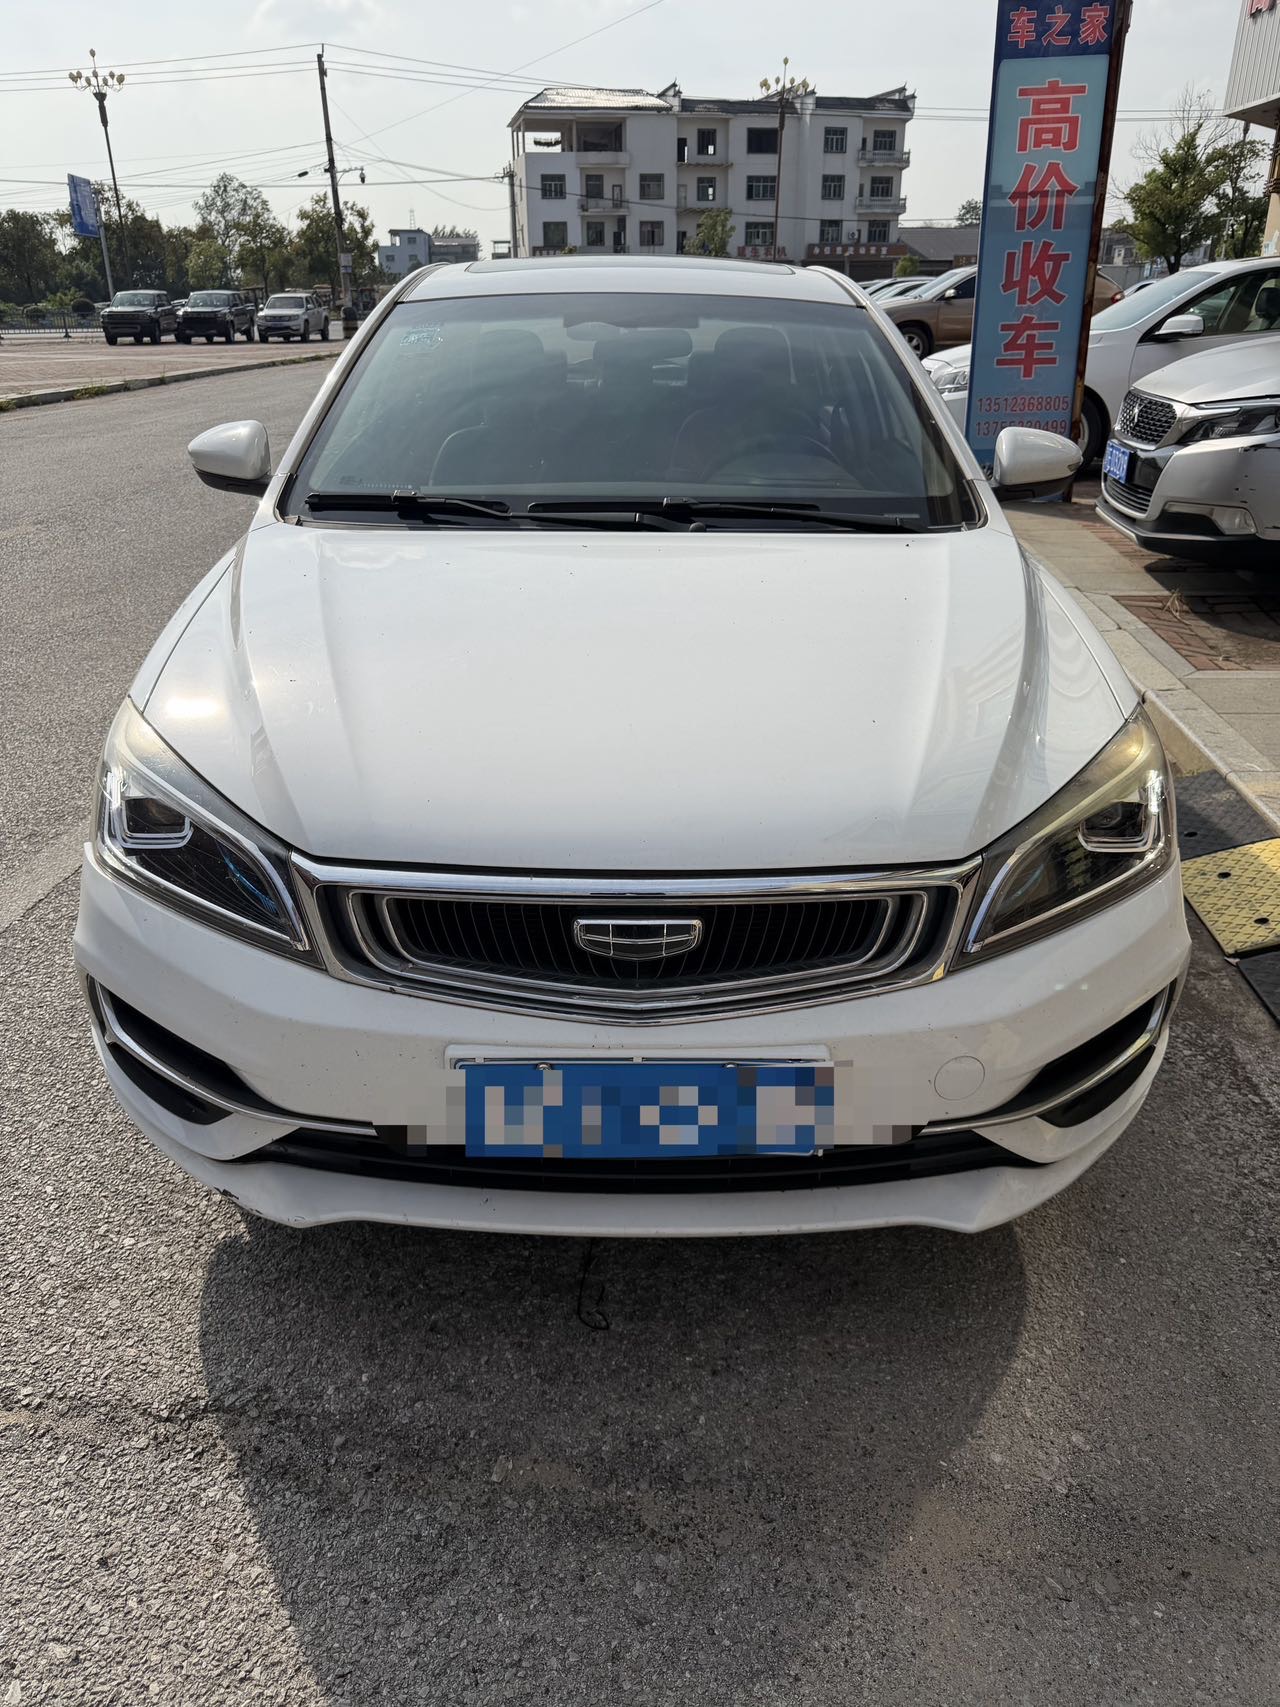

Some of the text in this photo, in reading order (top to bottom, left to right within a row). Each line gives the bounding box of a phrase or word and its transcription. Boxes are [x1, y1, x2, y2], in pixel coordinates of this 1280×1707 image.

[1008, 2, 1110, 49] 车之家
[995, 79, 1088, 380] 高价收车
[977, 395, 1069, 413] 13512368805
